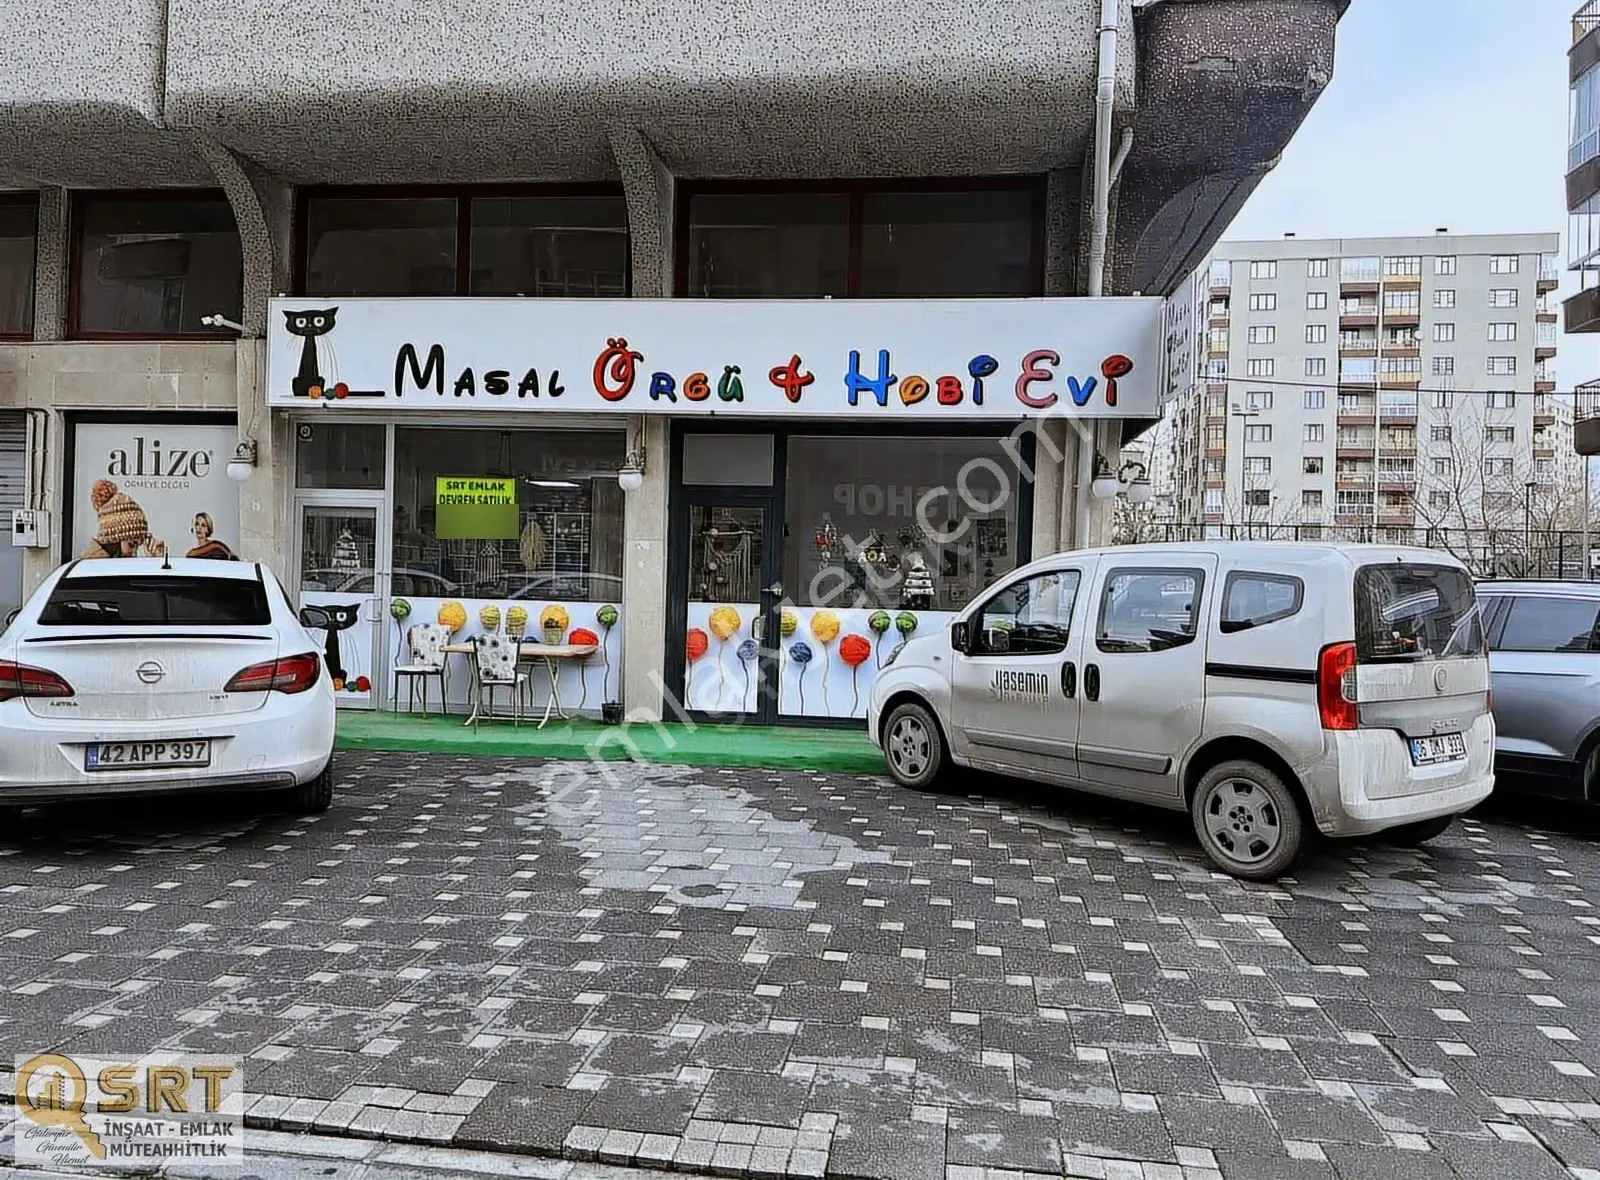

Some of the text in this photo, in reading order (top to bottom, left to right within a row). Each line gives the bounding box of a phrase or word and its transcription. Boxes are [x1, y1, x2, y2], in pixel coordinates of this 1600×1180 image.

[394, 342, 565, 398] MASAL
[593, 337, 744, 403] ÖRGÜ
[769, 354, 814, 402] &
[108, 437, 210, 477] alize
[446, 481, 505, 491] SRT EMLAK
[439, 494, 475, 504] DEVREN
[100, 744, 125, 763] 42
[129, 743, 166, 762] APP
[169, 742, 206, 760] 397
